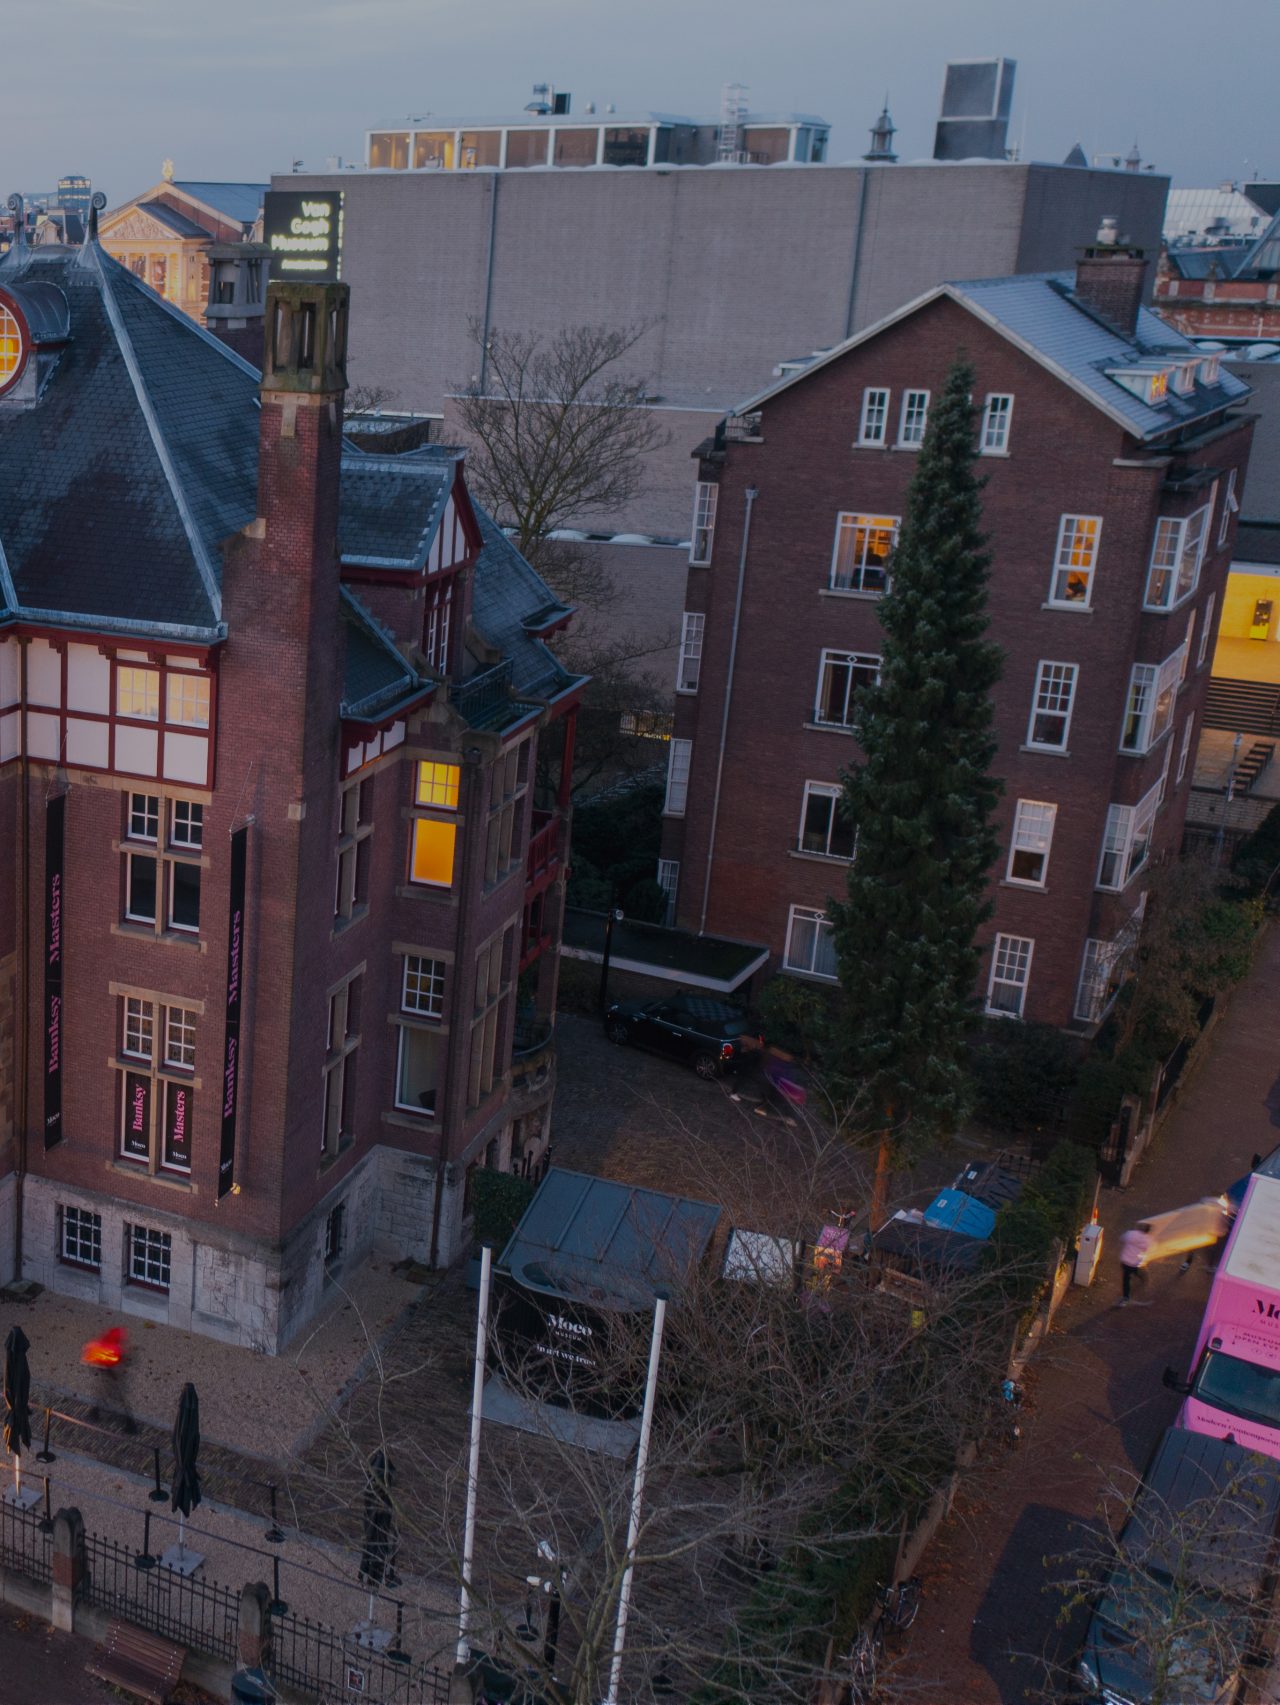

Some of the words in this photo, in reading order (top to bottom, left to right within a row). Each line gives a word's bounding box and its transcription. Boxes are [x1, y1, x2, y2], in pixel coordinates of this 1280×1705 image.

[302, 201, 330, 217] Van
[49, 873, 60, 967] Masters
[229, 911, 240, 1007] Masters
[48, 994, 60, 1073] Banksy
[132, 1083, 147, 1132] Banksy
[173, 1090, 186, 1142] Masters
[224, 1036, 237, 1118] Banksy
